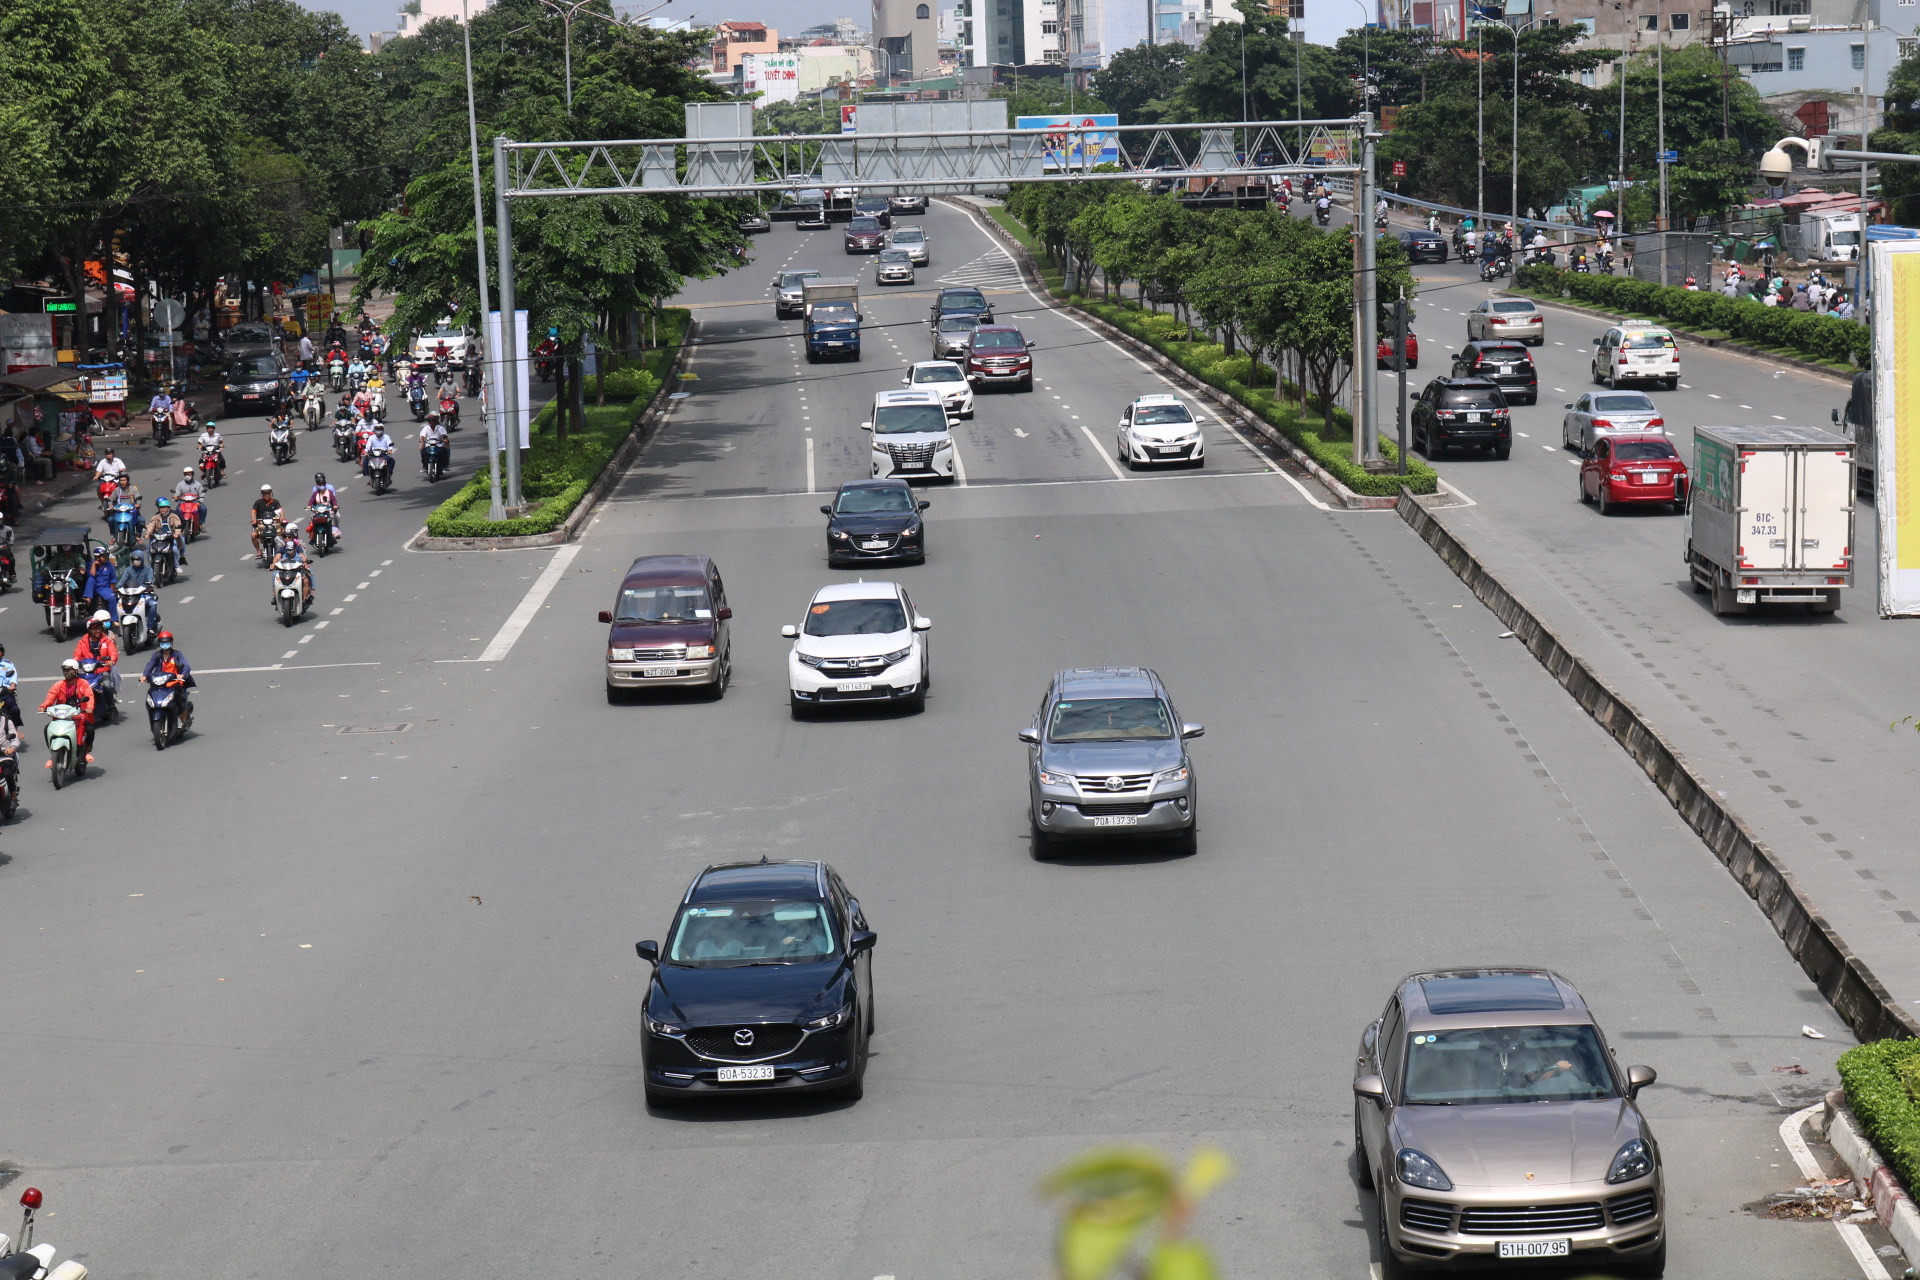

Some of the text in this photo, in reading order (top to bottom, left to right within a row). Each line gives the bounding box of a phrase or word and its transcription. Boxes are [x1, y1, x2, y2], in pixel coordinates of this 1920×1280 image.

[1751, 525, 1777, 536] 347.33
[1095, 816, 1136, 826] 70A-137.35
[720, 1067, 773, 1080] 60A-532.33
[1502, 1242, 1566, 1256] 51H-007.95
